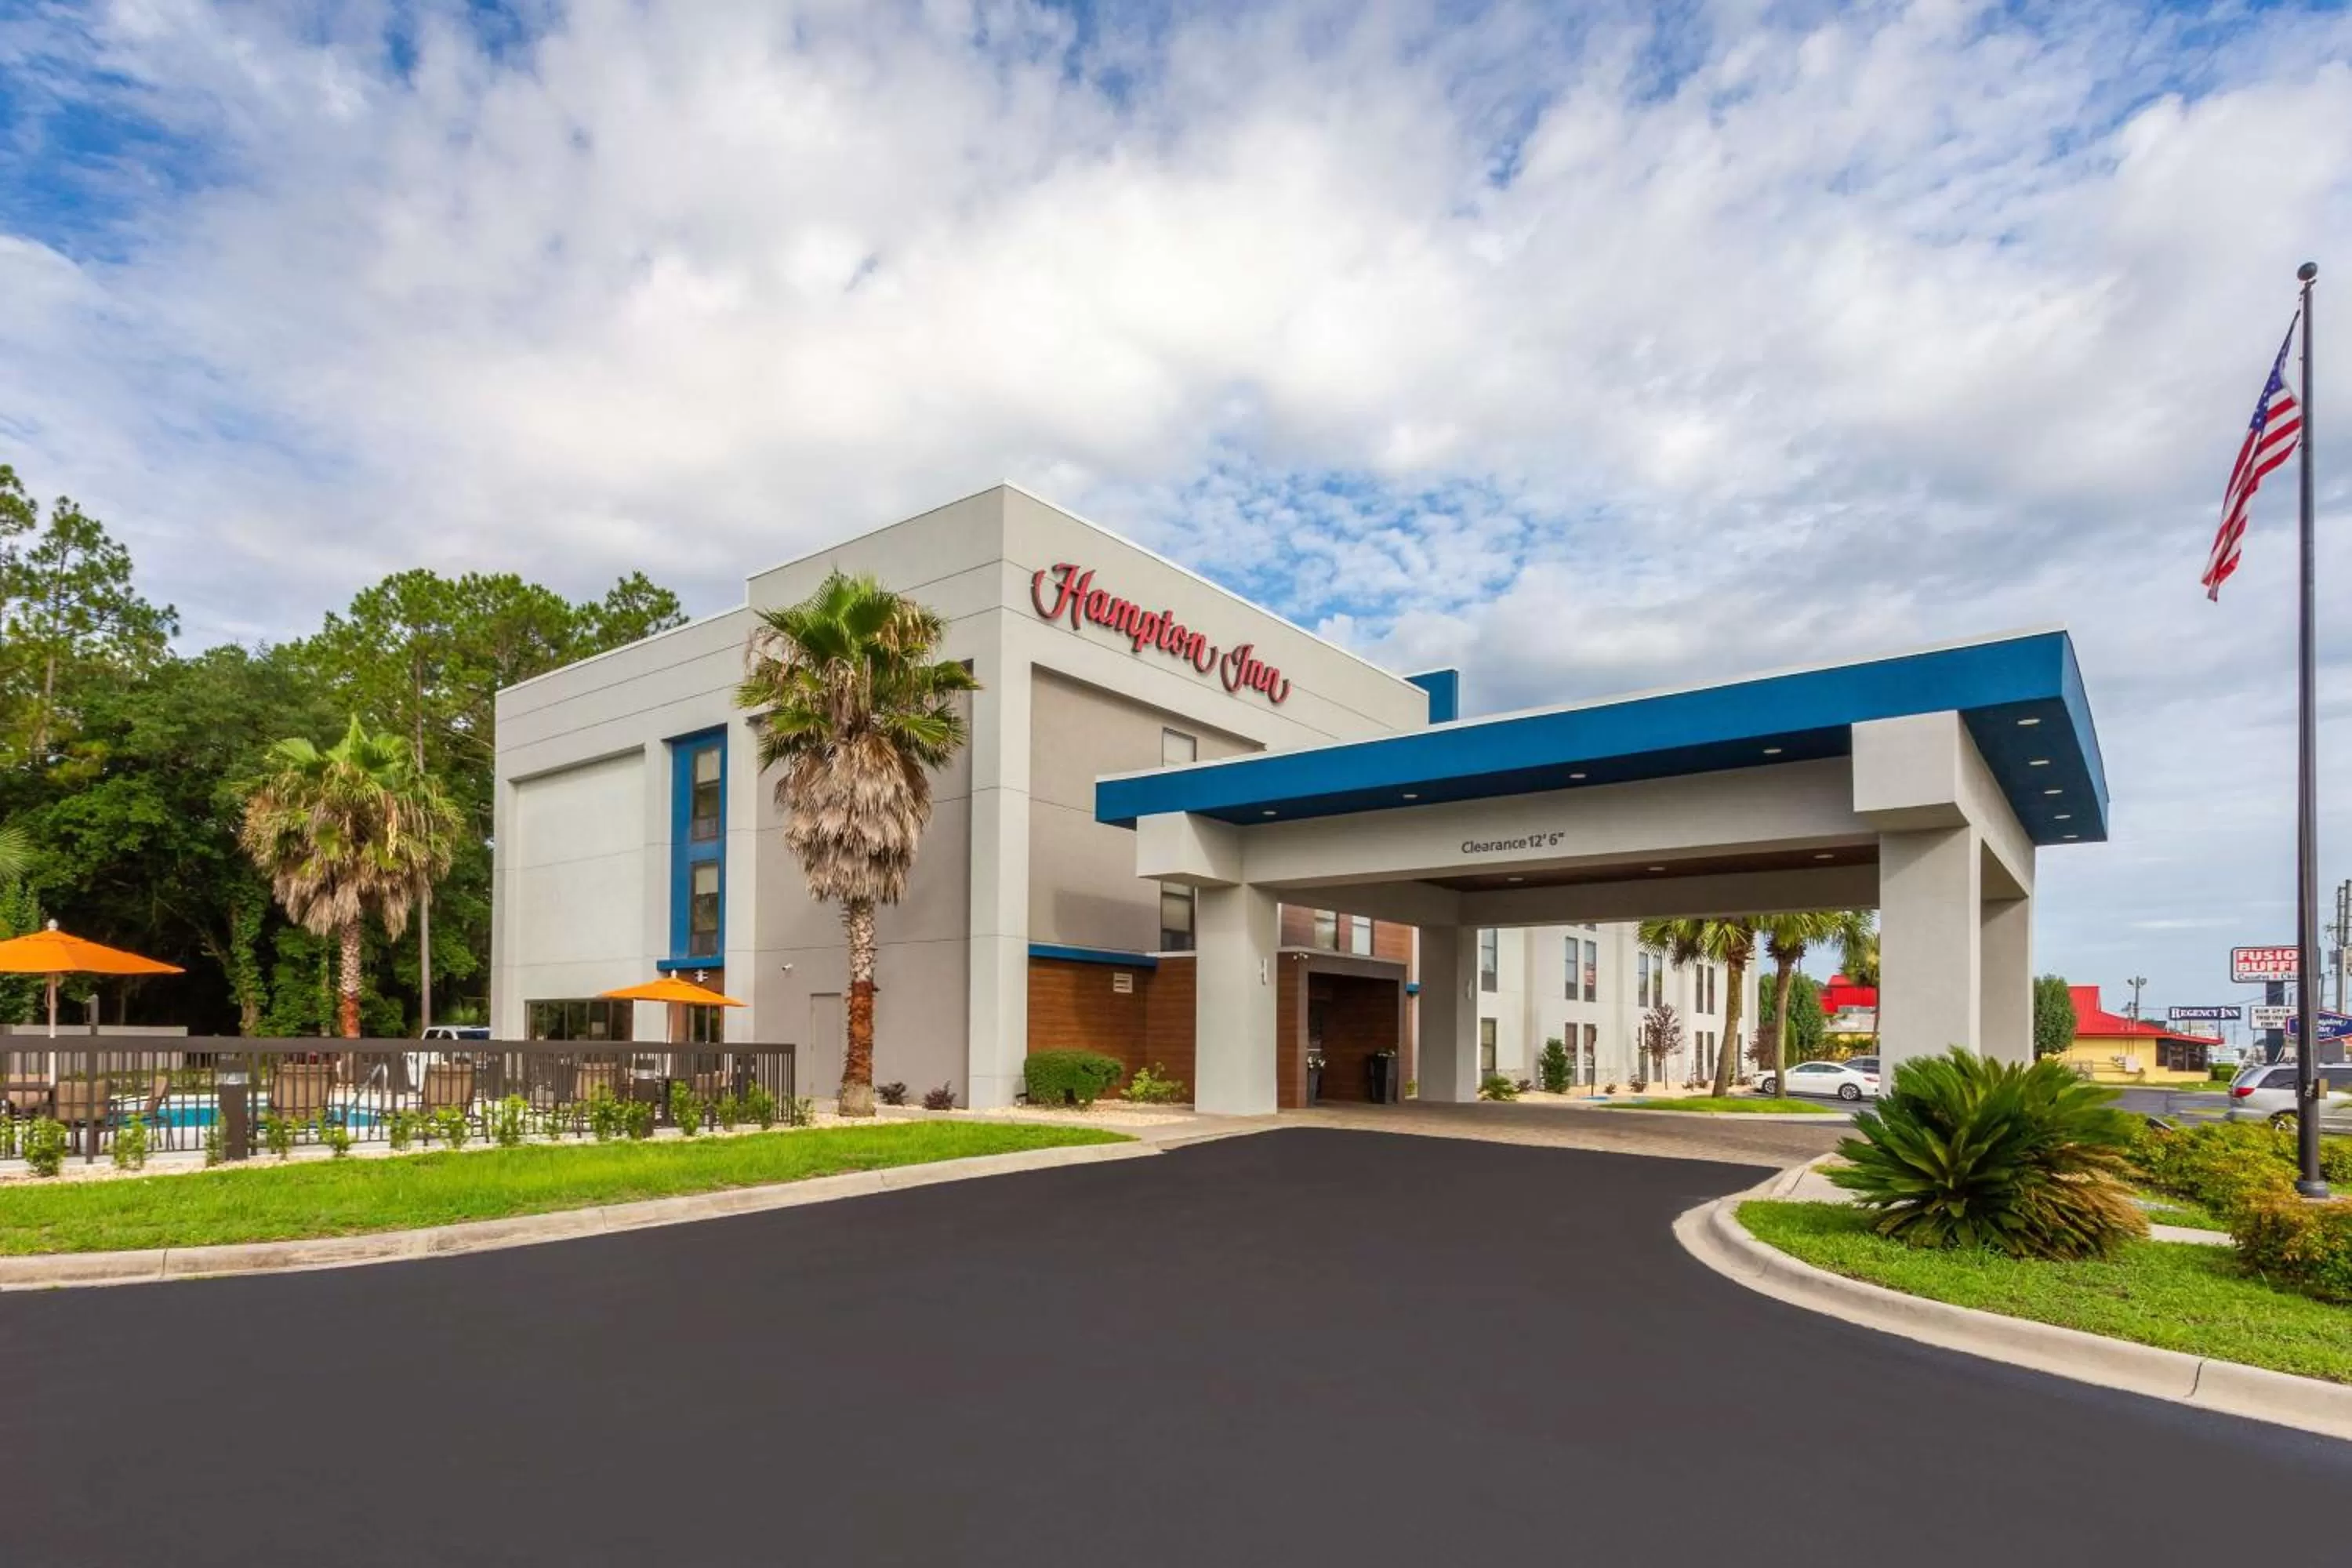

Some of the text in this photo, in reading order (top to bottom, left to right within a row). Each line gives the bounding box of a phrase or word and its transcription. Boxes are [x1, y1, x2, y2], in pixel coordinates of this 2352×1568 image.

[1031, 562, 1290, 703] Hampton Inn
[1461, 840, 1526, 854] Clearance
[2238, 949, 2299, 960] FUSIO
[2237, 960, 2299, 971] BUFF
[2171, 1007, 2239, 1018] REGENCY INN
